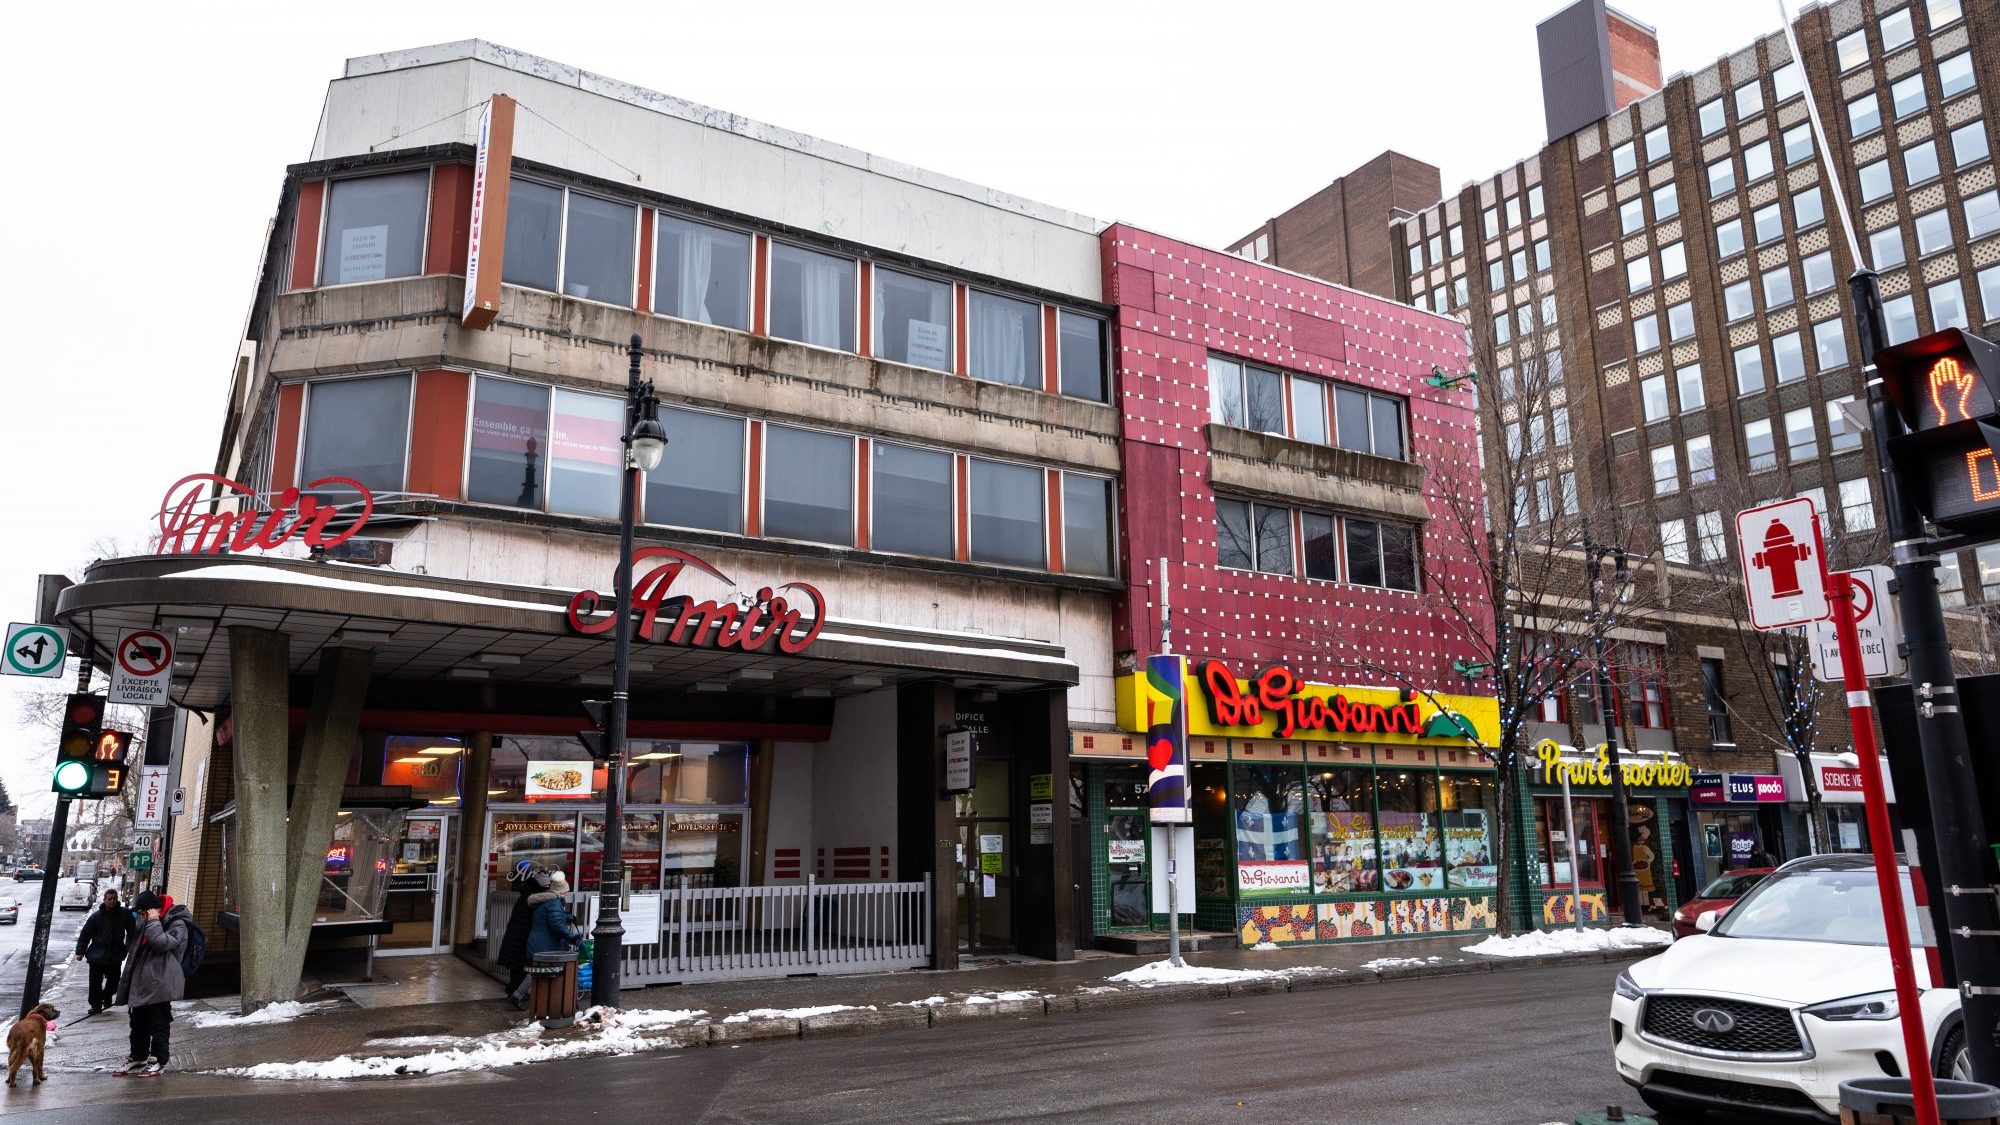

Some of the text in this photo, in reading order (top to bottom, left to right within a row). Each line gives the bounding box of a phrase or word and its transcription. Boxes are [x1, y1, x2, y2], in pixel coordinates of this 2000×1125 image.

[473, 417, 517, 432] Ensemble
[156, 473, 373, 554] Amir
[567, 546, 826, 653] Amir
[1867, 643, 1881, 654] DÉC
[122, 678, 159, 687] EXCEPTÉ
[117, 685, 163, 694] LIVRAISON
[122, 692, 155, 700] LOCALE
[107, 770, 120, 790] 3
[1824, 773, 1851, 787] SCIENCE
[1134, 783, 1149, 793] 57
[505, 822, 567, 831] JOYEUSES FÊTES
[136, 836, 151, 847] 40
[142, 856, 150, 865] P
